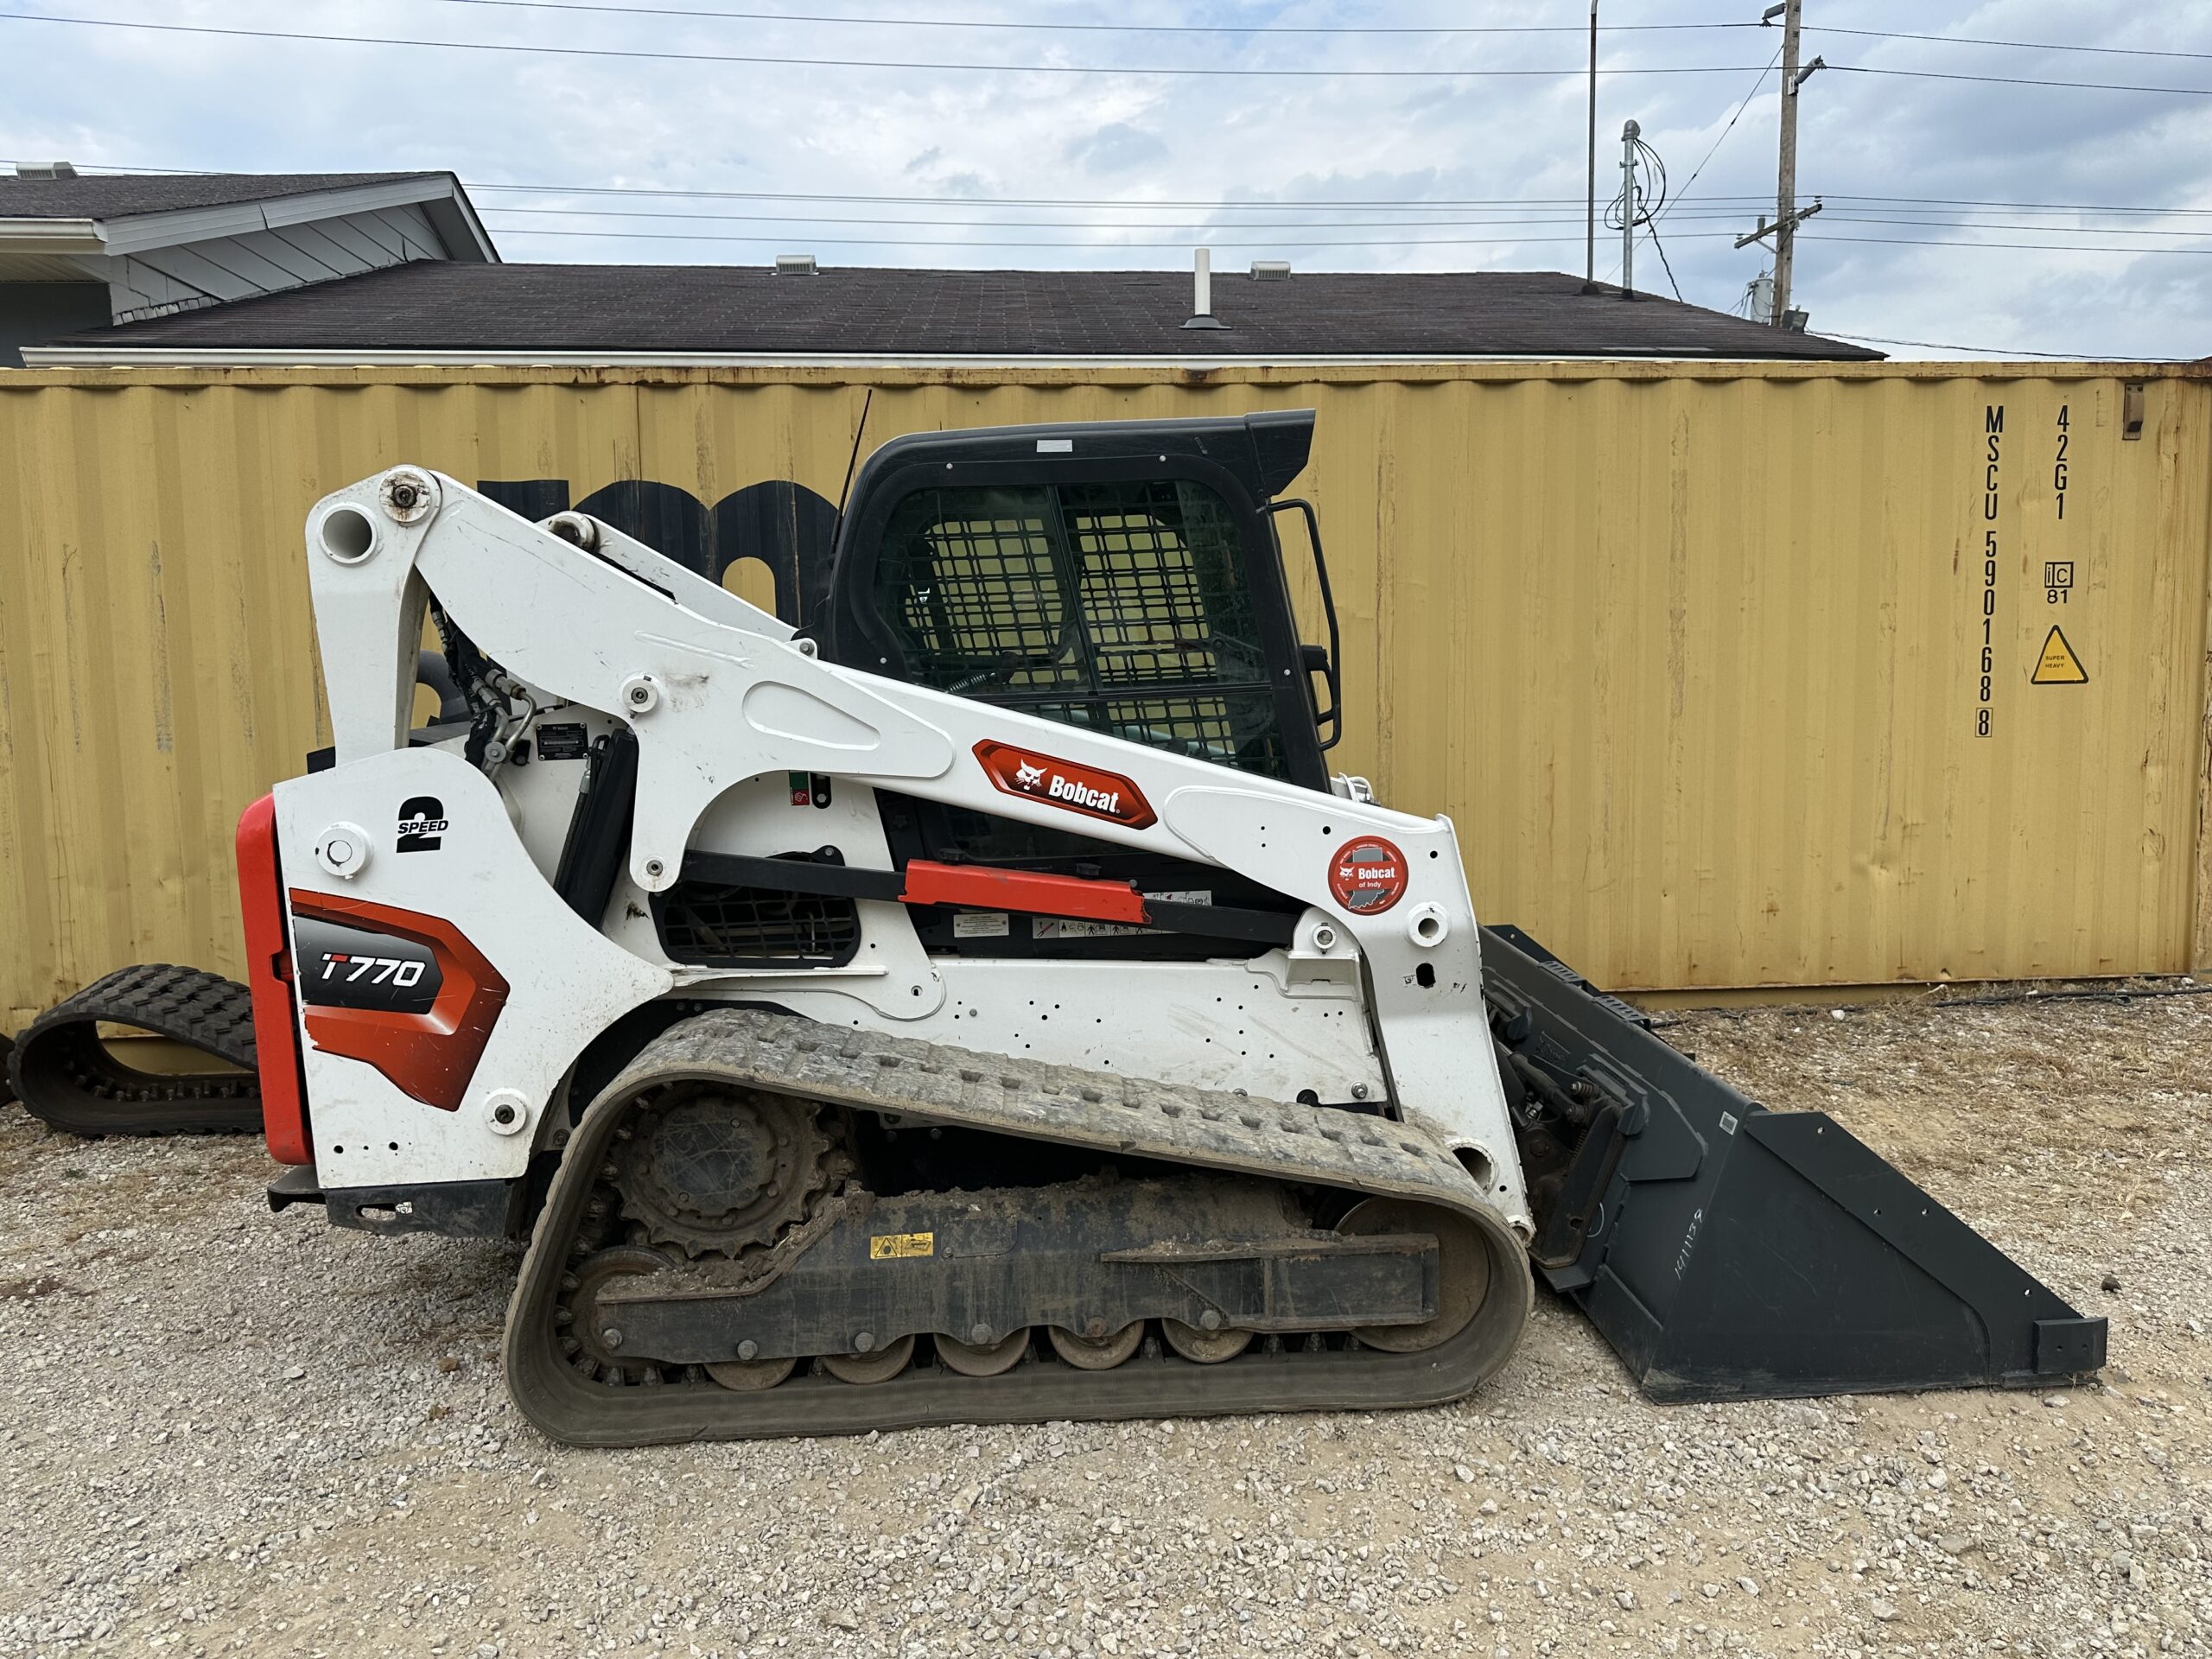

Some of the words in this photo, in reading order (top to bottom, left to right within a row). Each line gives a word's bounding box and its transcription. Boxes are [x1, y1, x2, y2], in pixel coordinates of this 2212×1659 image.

[1985, 405, 2004, 520] MSCU
[2055, 405, 2069, 519] 42G1
[2047, 589, 2068, 604] 81
[1980, 531, 1997, 702] 590168
[1048, 775, 1119, 813] Bobcat
[397, 796, 443, 853] 2
[397, 820, 448, 834] SPEED
[1358, 868, 1395, 880] Bobcat
[321, 953, 426, 987] T770
